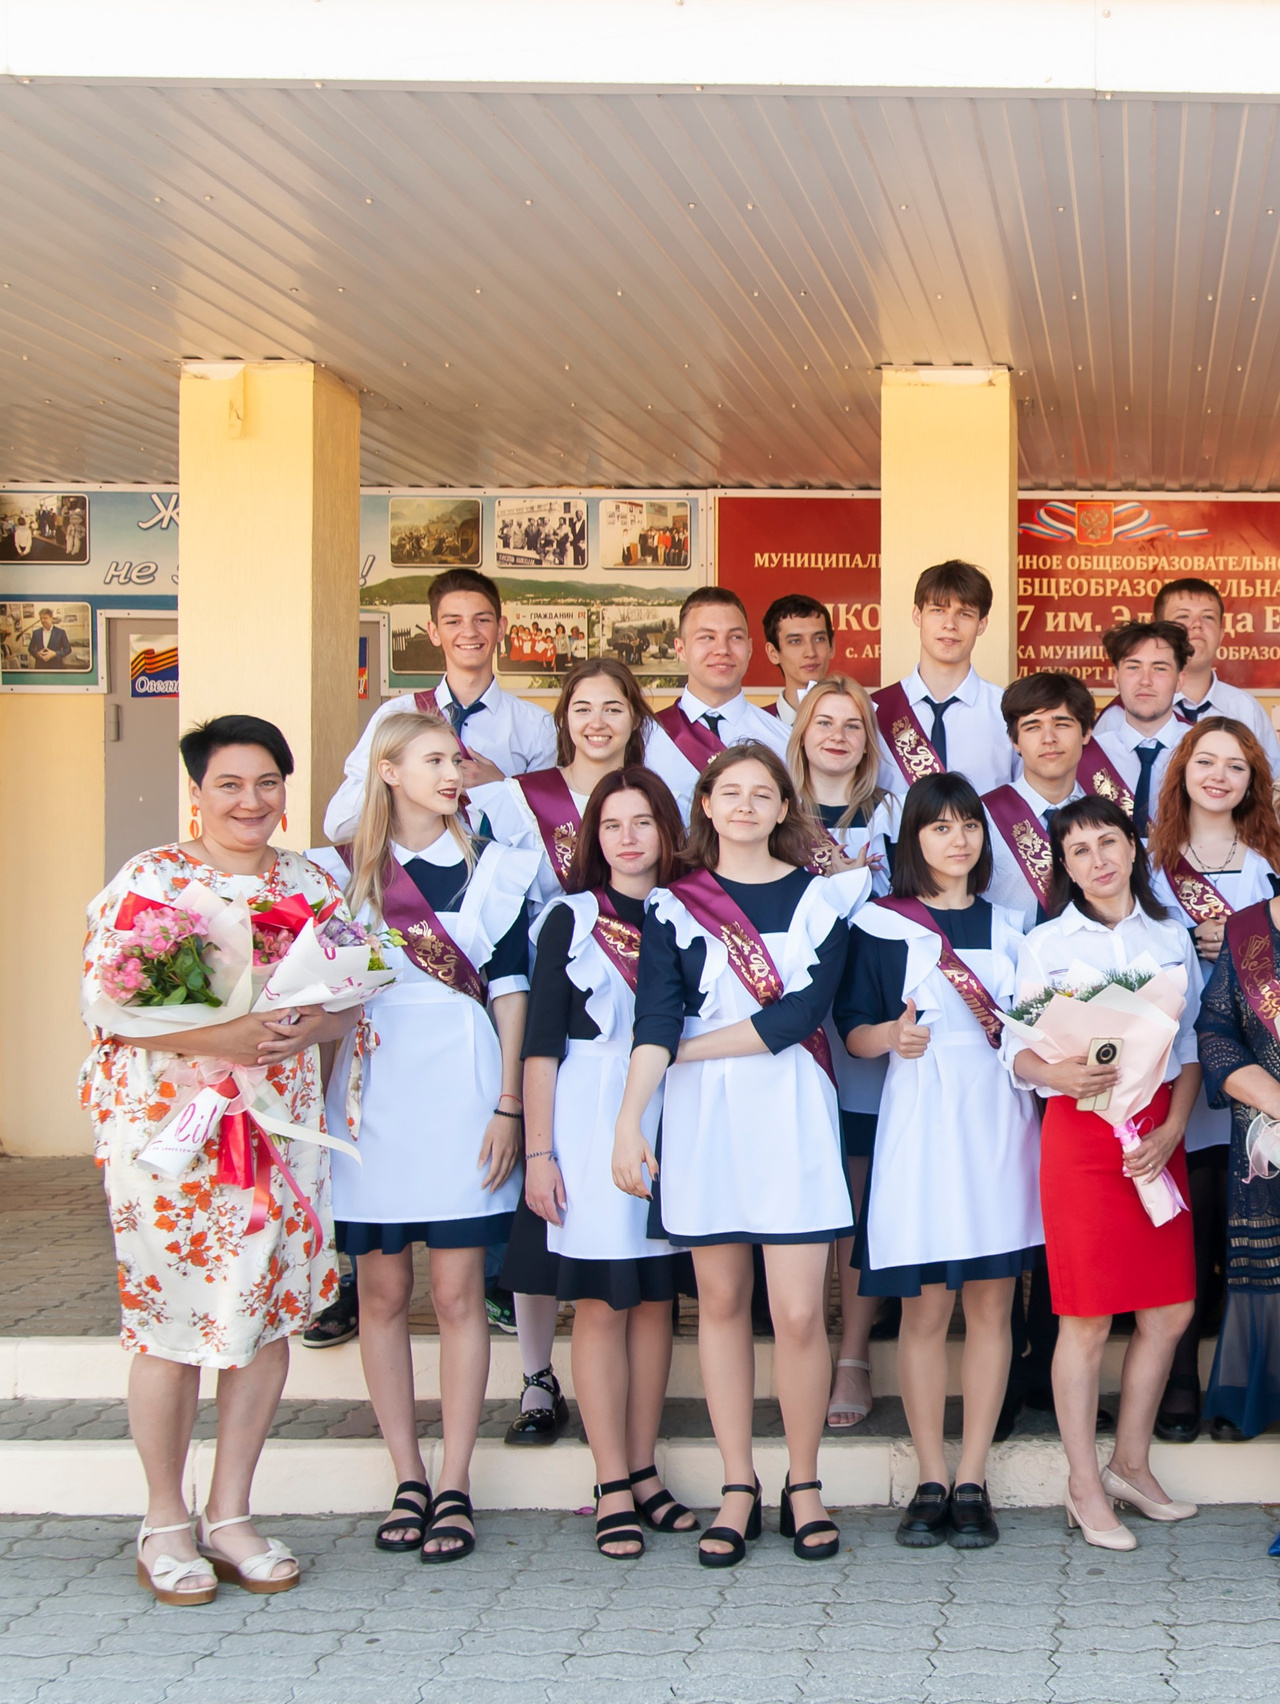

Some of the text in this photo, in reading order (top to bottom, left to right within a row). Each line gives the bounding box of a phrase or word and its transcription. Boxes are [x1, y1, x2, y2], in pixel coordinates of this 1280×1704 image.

[104, 561, 159, 585] не
[529, 612, 574, 620] ГРАЖДАНИН
[1045, 611, 1102, 633] им.
